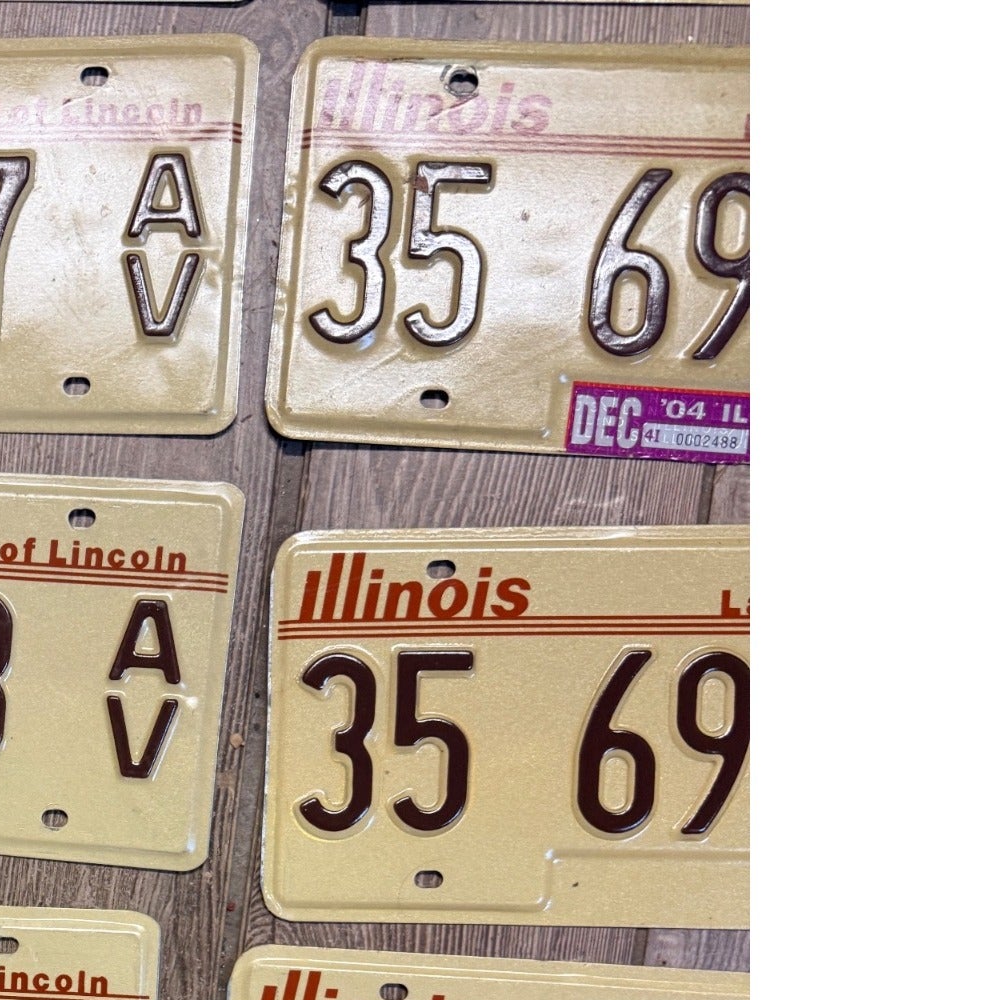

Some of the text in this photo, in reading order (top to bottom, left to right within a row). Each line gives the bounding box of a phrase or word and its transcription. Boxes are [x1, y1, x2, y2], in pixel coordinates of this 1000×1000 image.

[12, 97, 48, 126] of
[62, 98, 201, 126] Lincoln
[319, 62, 554, 135] Illinois
[309, 159, 492, 348] 35
[571, 394, 642, 449] DEC
[722, 402, 748, 423] IL
[0, 537, 36, 564] of
[49, 539, 187, 572] Lincoln
[300, 552, 531, 621] Illinois
[300, 650, 474, 832] 35
